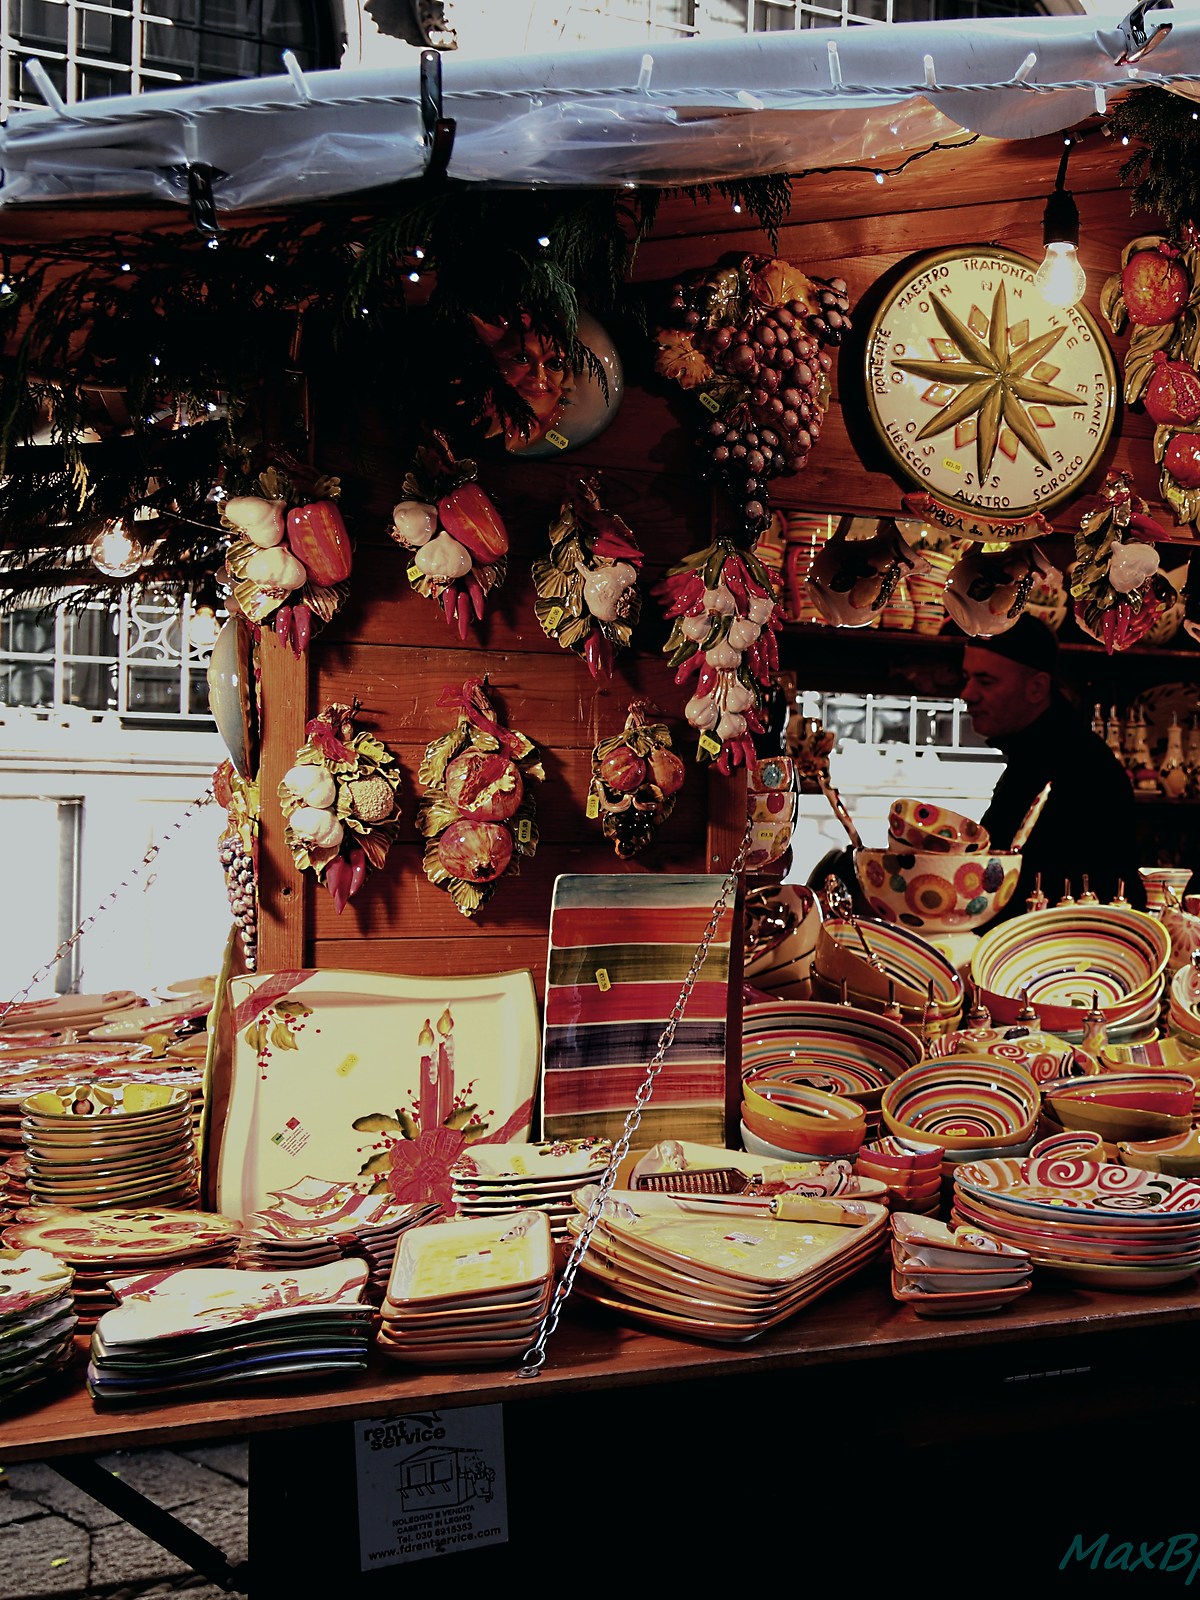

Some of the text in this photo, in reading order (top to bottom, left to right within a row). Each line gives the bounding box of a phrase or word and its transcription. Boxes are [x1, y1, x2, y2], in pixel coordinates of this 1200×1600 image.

[961, 259, 1037, 287] TRAMONTA
[898, 266, 951, 310] MAESTRO
[918, 286, 952, 313] O N
[982, 281, 1023, 299] N N
[1062, 307, 1091, 342] RECO
[1066, 337, 1079, 349] E
[874, 328, 893, 394] PONENTE
[1088, 373, 1105, 438] LEVANTE
[885, 421, 932, 477] LIBECCIO
[1033, 455, 1084, 501] SCIROCCO
[953, 489, 1010, 509] AUSTRO
[988, 522, 1027, 538] VENTI
[364, 1421, 407, 1441] rent
[370, 1427, 446, 1451] service
[392, 1513, 434, 1527] NOLEGGIO
[442, 1505, 475, 1517] VENDITA
[397, 1514, 471, 1534] CASETTE IN LEGNO
[368, 1526, 501, 1561] www.fdrentservice.com
[397, 1534, 414, 1544] Tel.
[416, 1530, 433, 1540] 030
